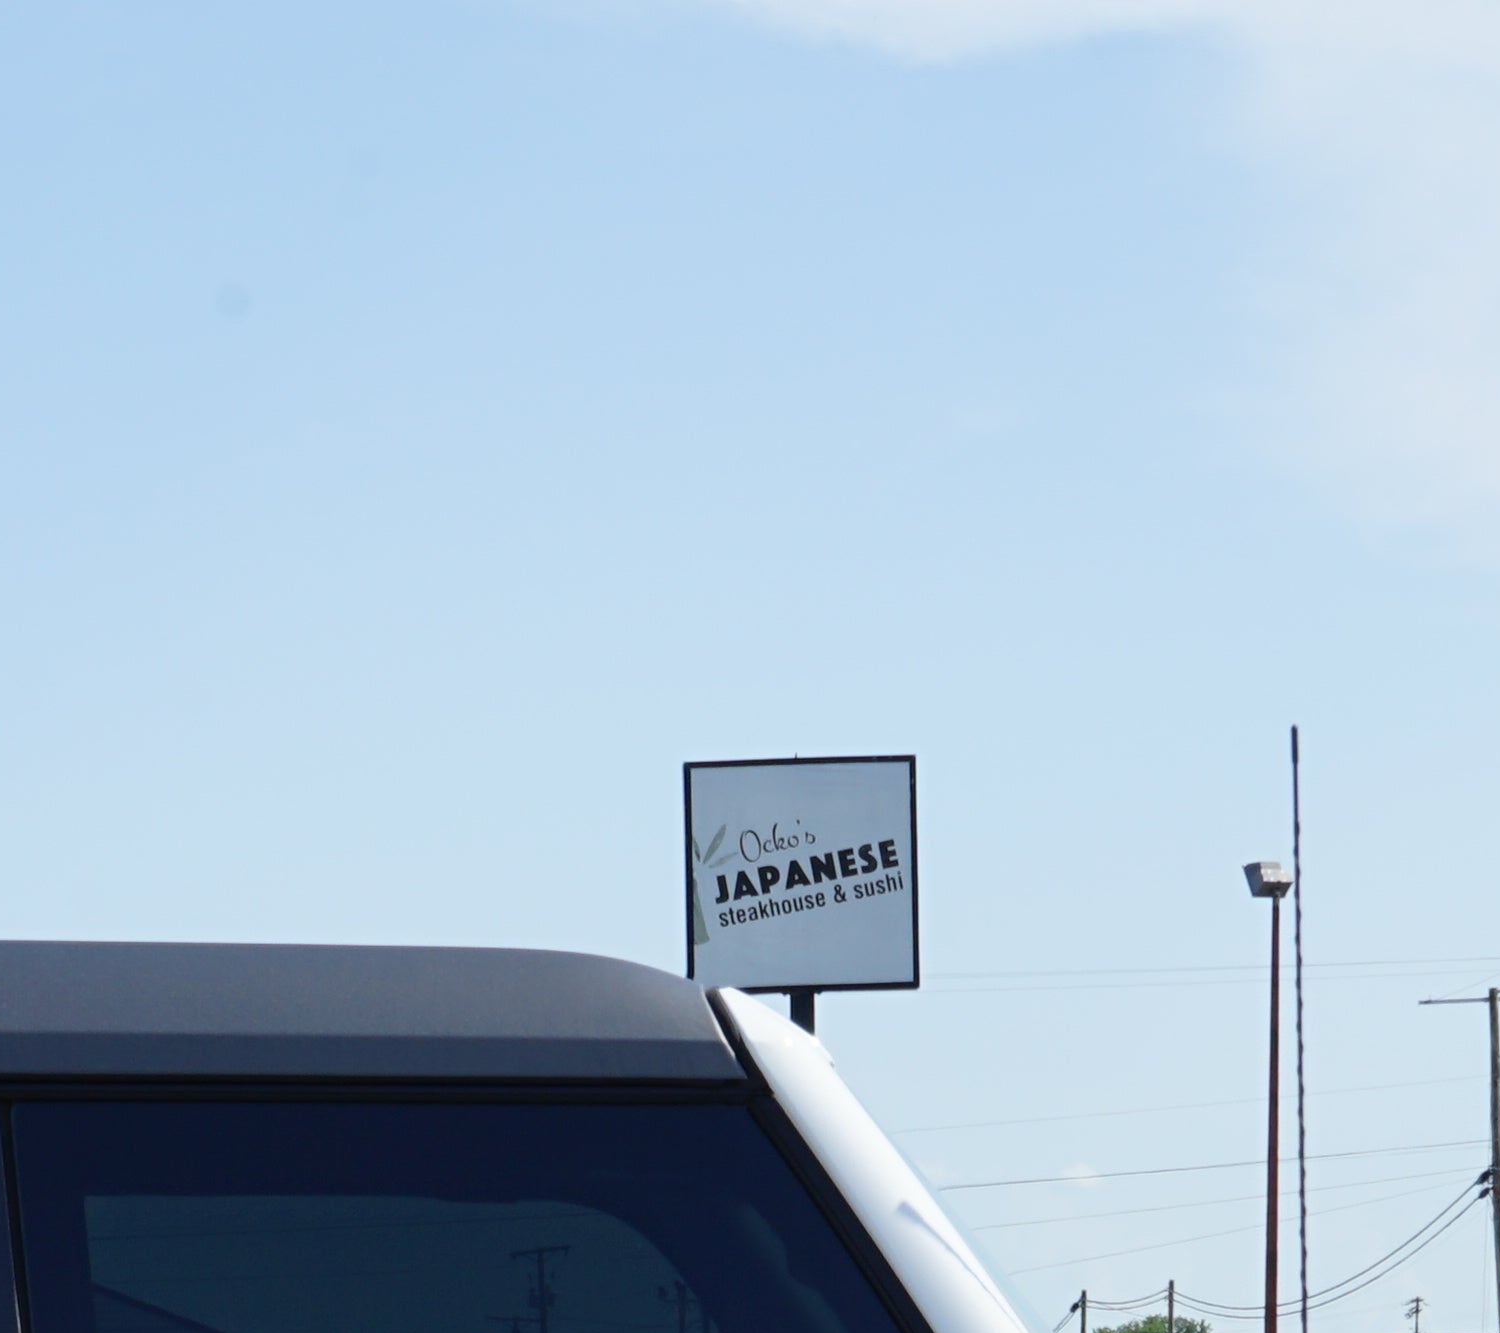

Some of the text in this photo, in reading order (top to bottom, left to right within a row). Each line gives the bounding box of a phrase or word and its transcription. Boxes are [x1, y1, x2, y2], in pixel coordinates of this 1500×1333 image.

[740, 819, 816, 862] Ocko's
[715, 839, 899, 904] JAPANESE
[719, 871, 904, 927] steakhouse & sushi
